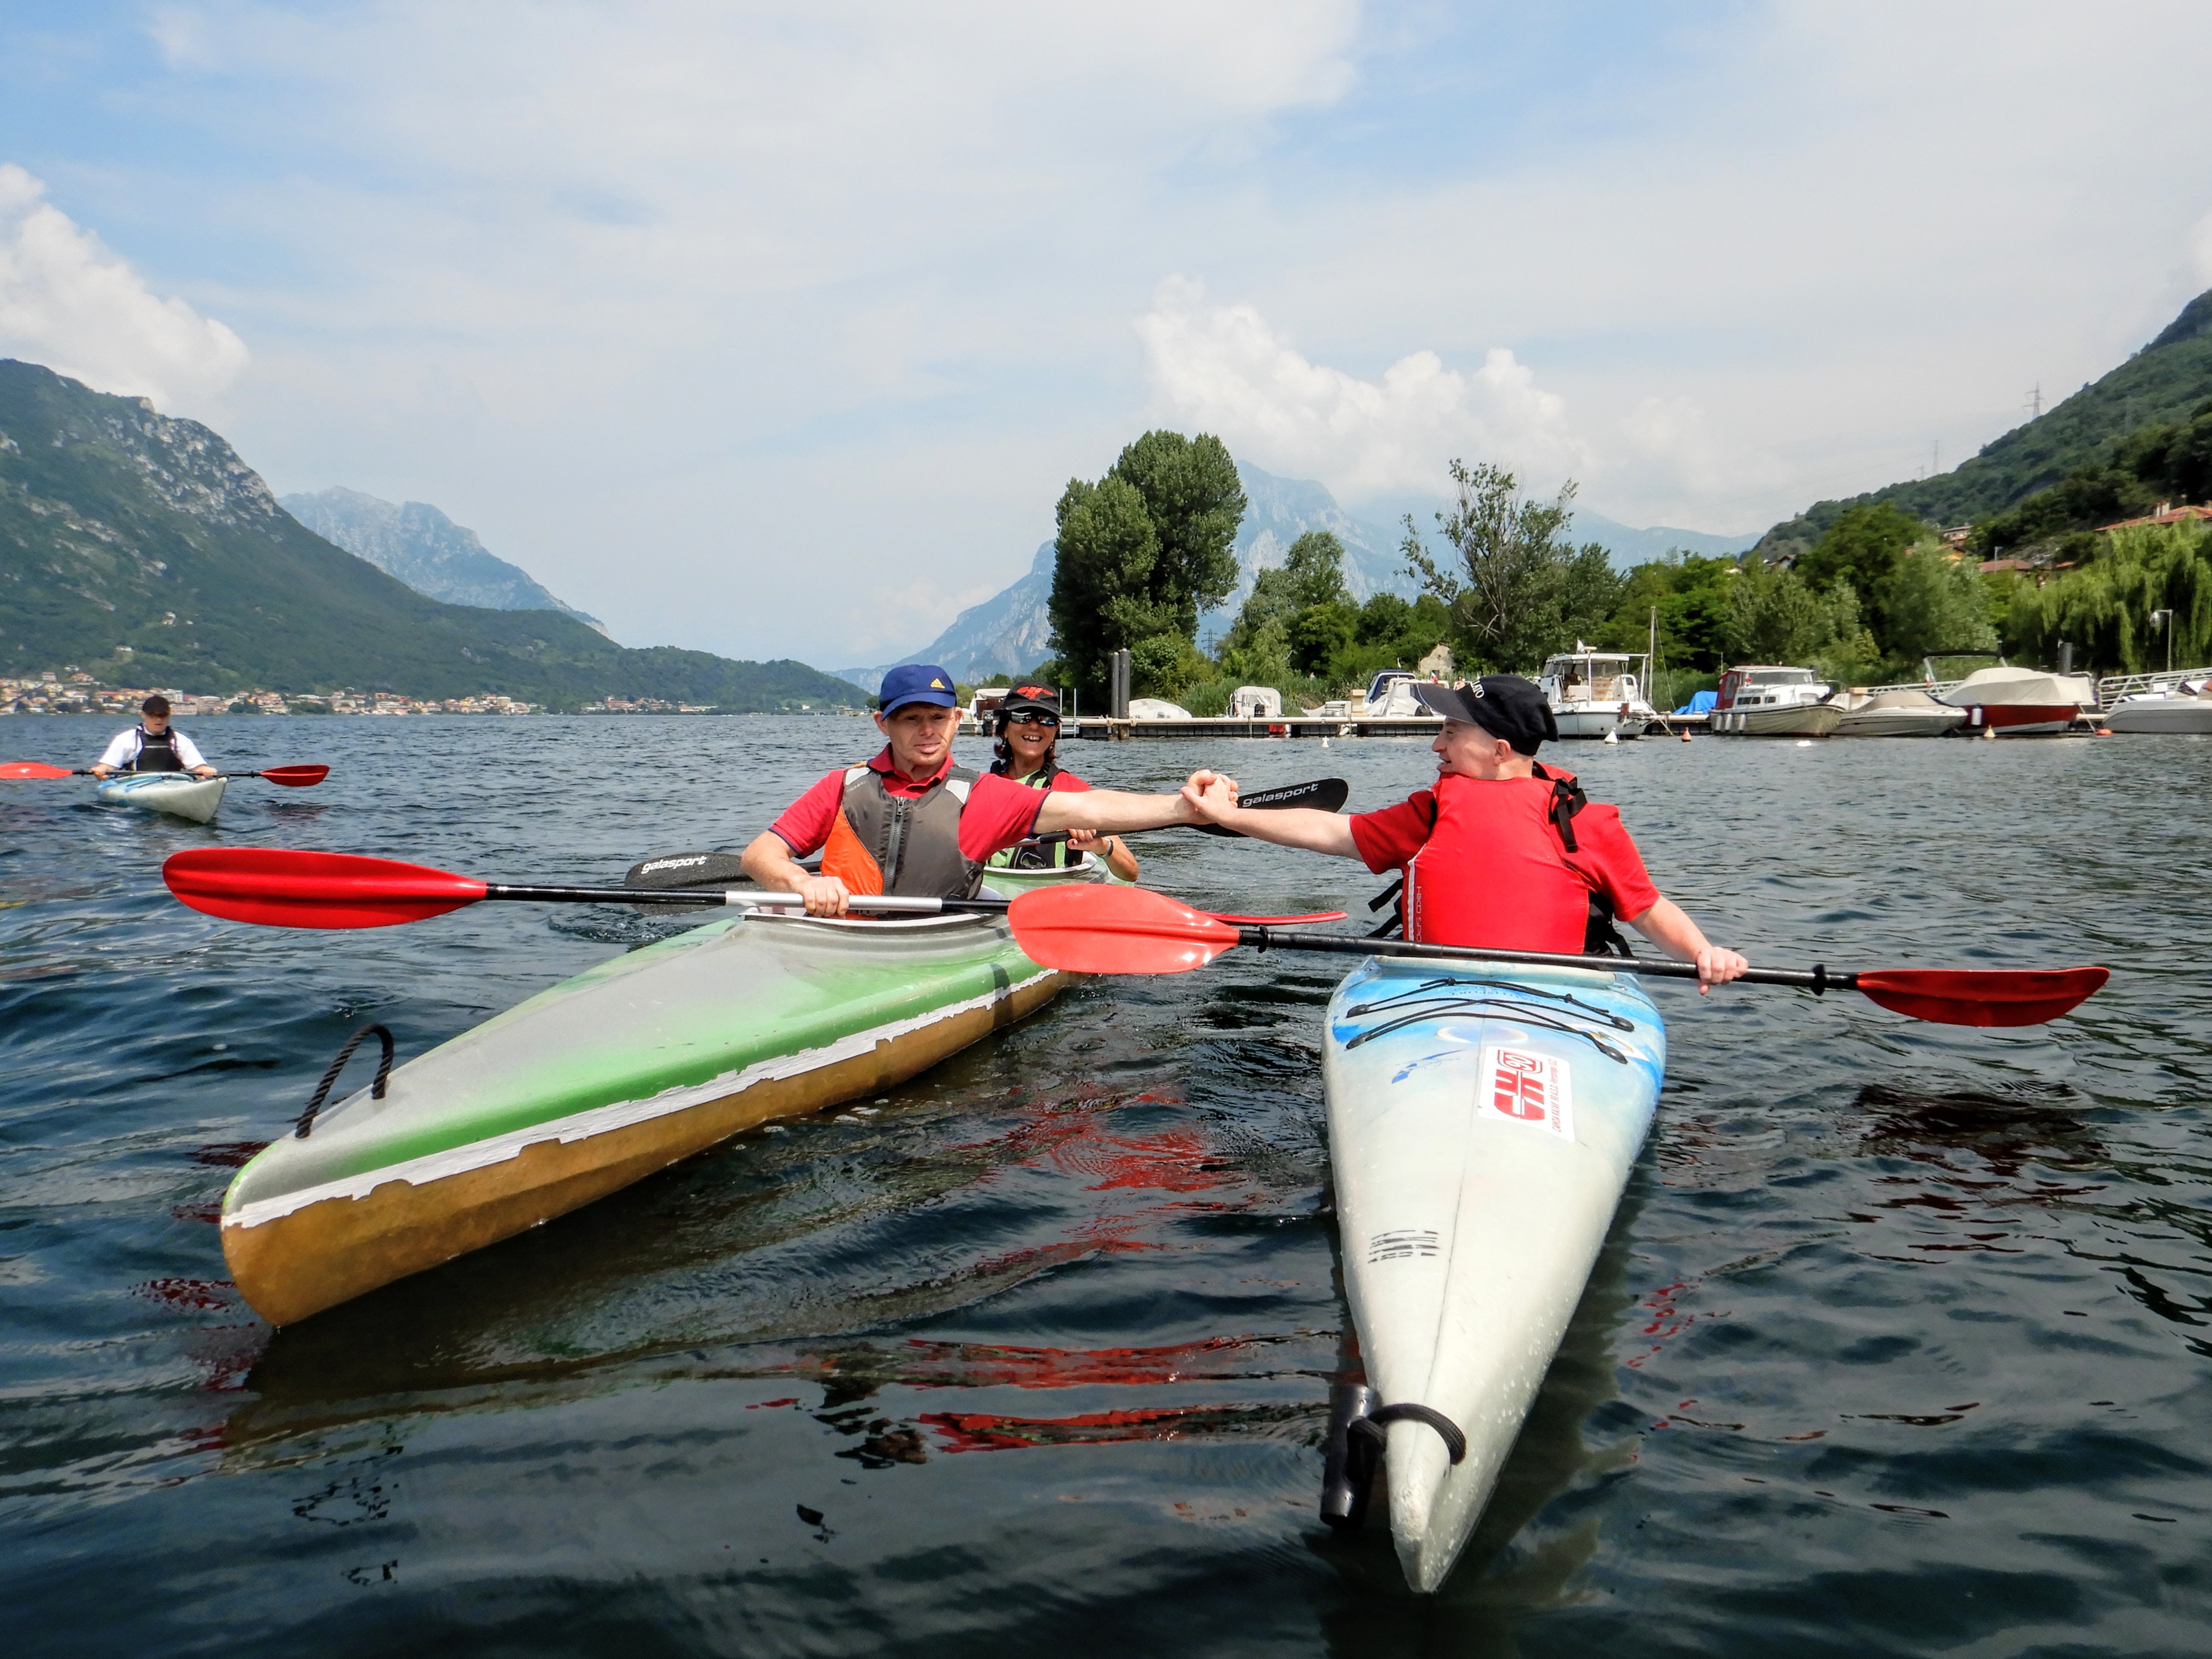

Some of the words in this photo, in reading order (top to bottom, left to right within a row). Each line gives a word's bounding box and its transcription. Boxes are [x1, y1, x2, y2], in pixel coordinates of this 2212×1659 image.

[1242, 783, 1318, 807] galasport
[641, 855, 707, 874] galasport
[1505, 1054, 1534, 1072] 90
